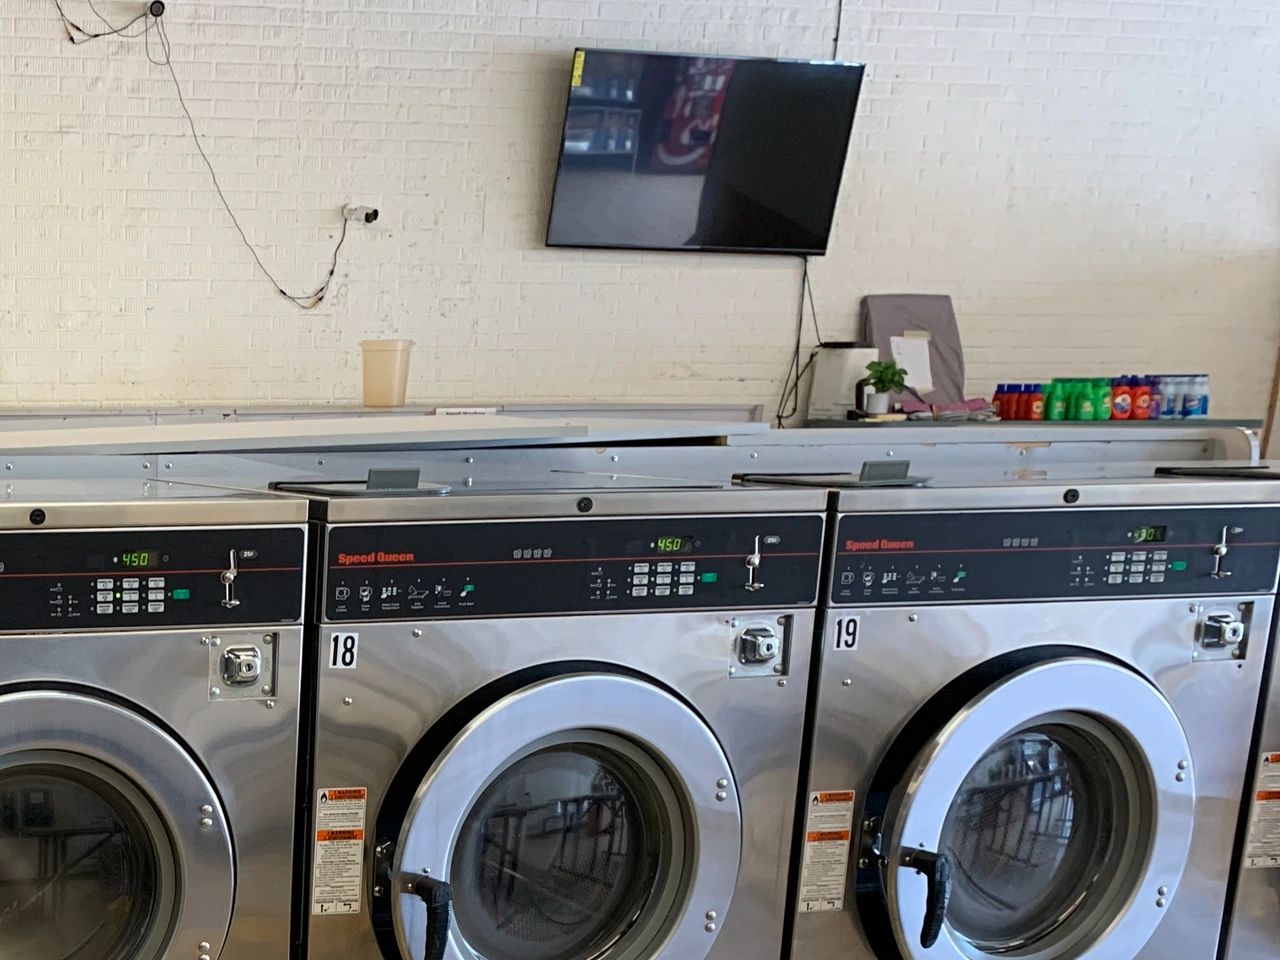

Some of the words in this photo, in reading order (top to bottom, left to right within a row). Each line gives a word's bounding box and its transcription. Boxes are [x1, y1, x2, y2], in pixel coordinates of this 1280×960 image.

[657, 538, 681, 550] 450
[846, 540, 879, 551] Speed
[880, 539, 914, 549] Queen
[123, 554, 148, 566] 450
[338, 553, 375, 565] Speed
[377, 552, 414, 562] Queen
[836, 618, 857, 648] 19
[332, 635, 355, 666] 18
